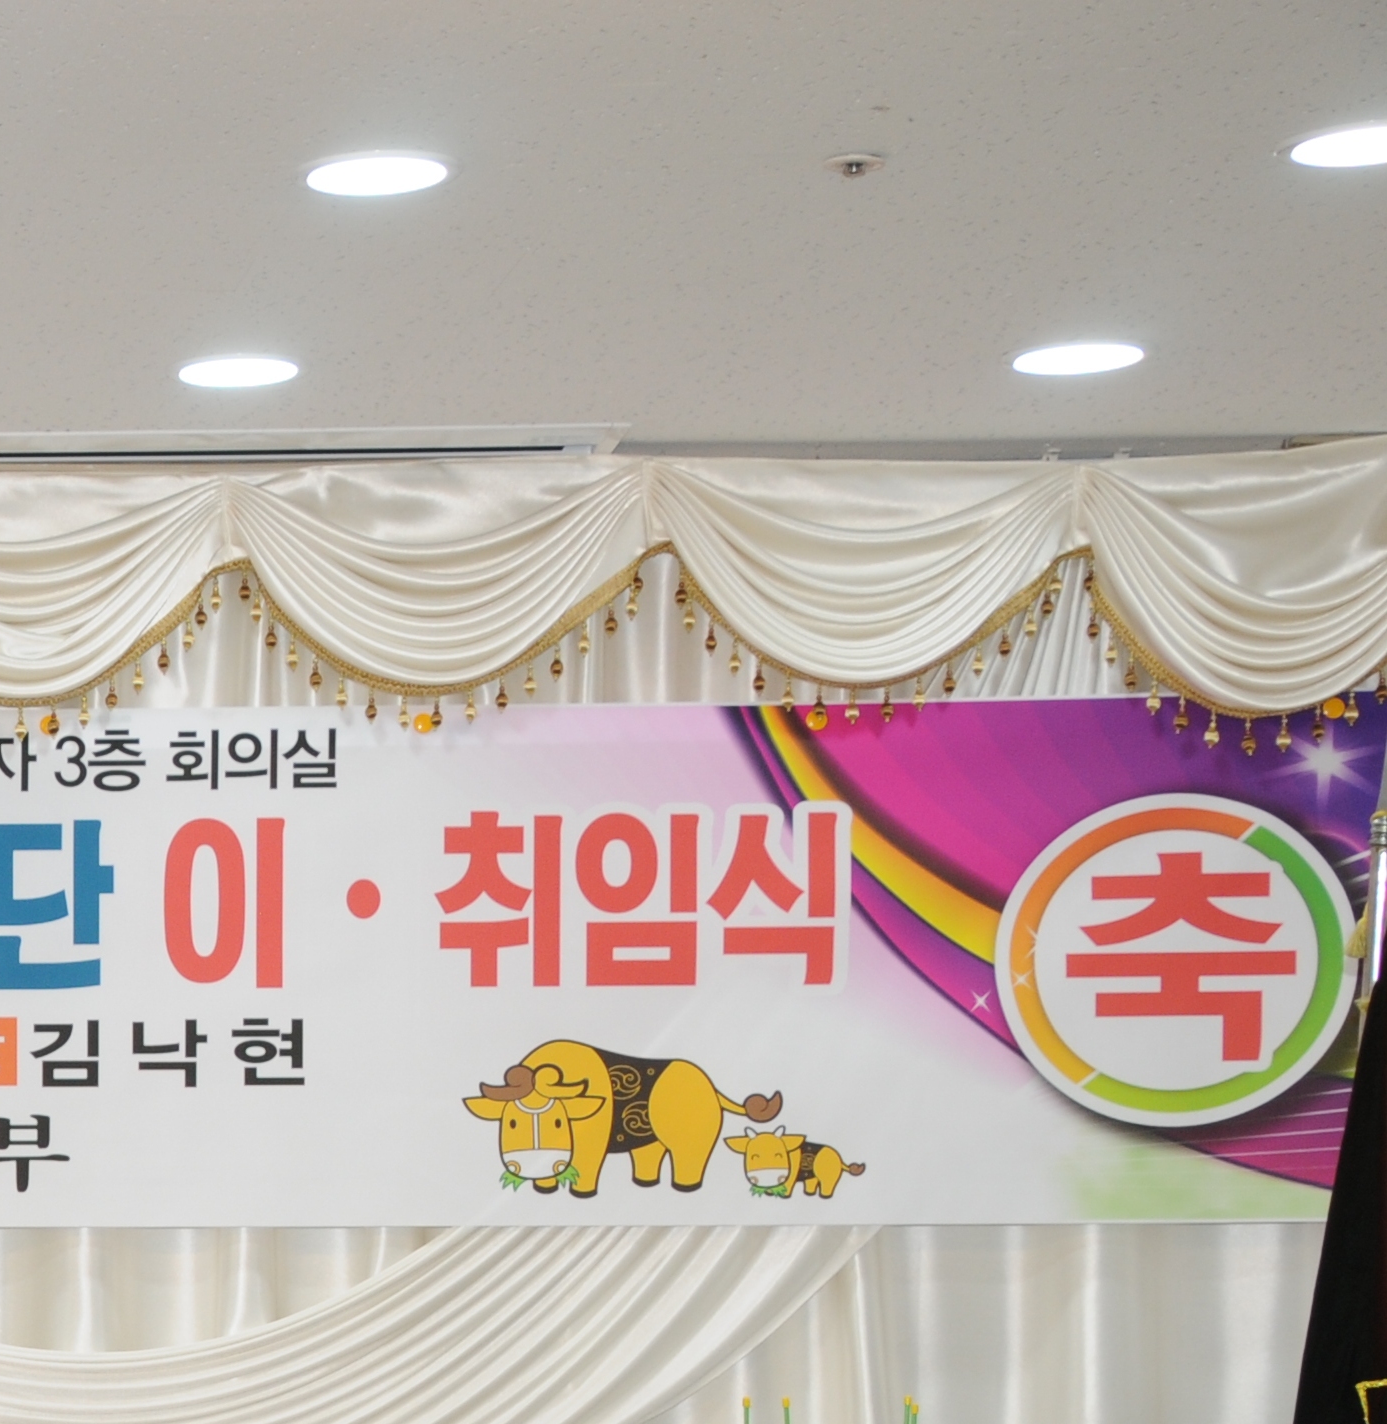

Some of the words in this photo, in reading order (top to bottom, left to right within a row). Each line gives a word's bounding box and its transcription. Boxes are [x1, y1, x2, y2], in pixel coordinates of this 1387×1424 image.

[54, 730, 146, 792] 3층
[166, 728, 337, 790] 회의실
[1065, 851, 1298, 1063] 축
